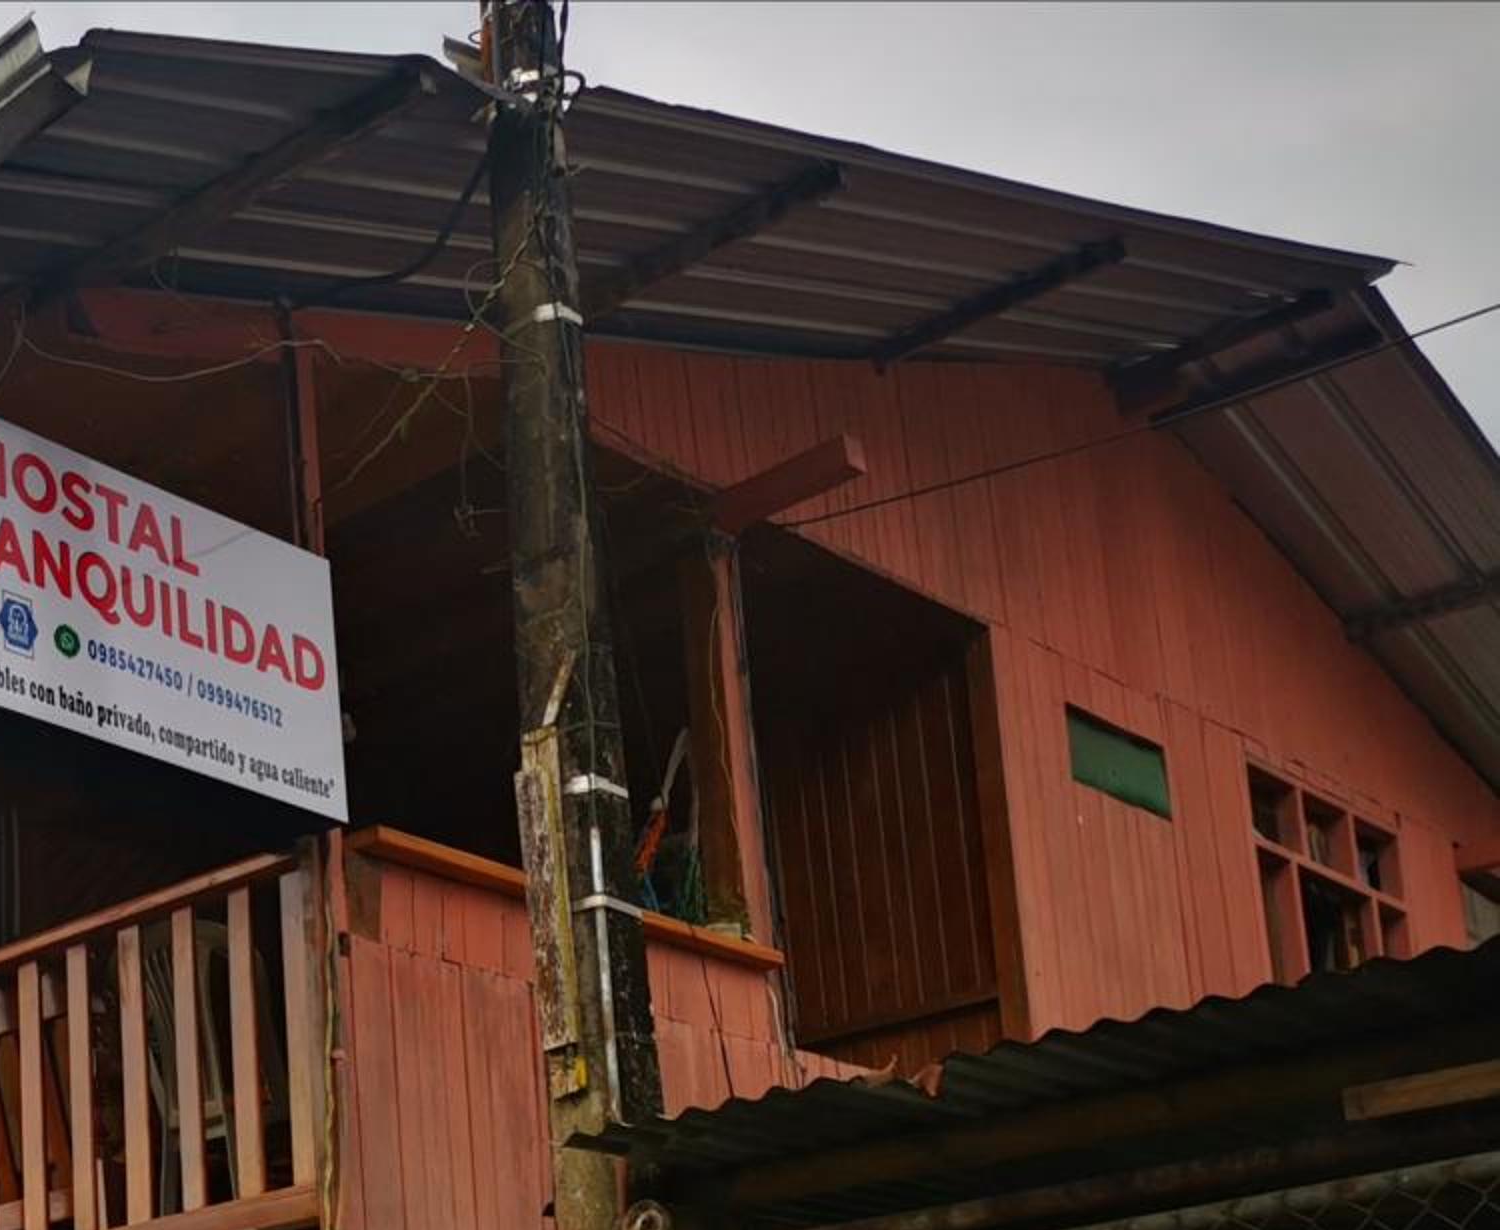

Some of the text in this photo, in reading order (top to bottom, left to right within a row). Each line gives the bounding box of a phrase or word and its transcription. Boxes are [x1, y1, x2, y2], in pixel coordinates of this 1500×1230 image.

[87, 639, 183, 690] 0985427450
[197, 679, 283, 727] 0999476512
[29, 681, 56, 706] con
[58, 686, 93, 718] baño
[97, 705, 156, 744] privado,
[159, 725, 235, 766] compartido
[238, 753, 247, 775] y
[250, 758, 279, 782] agua
